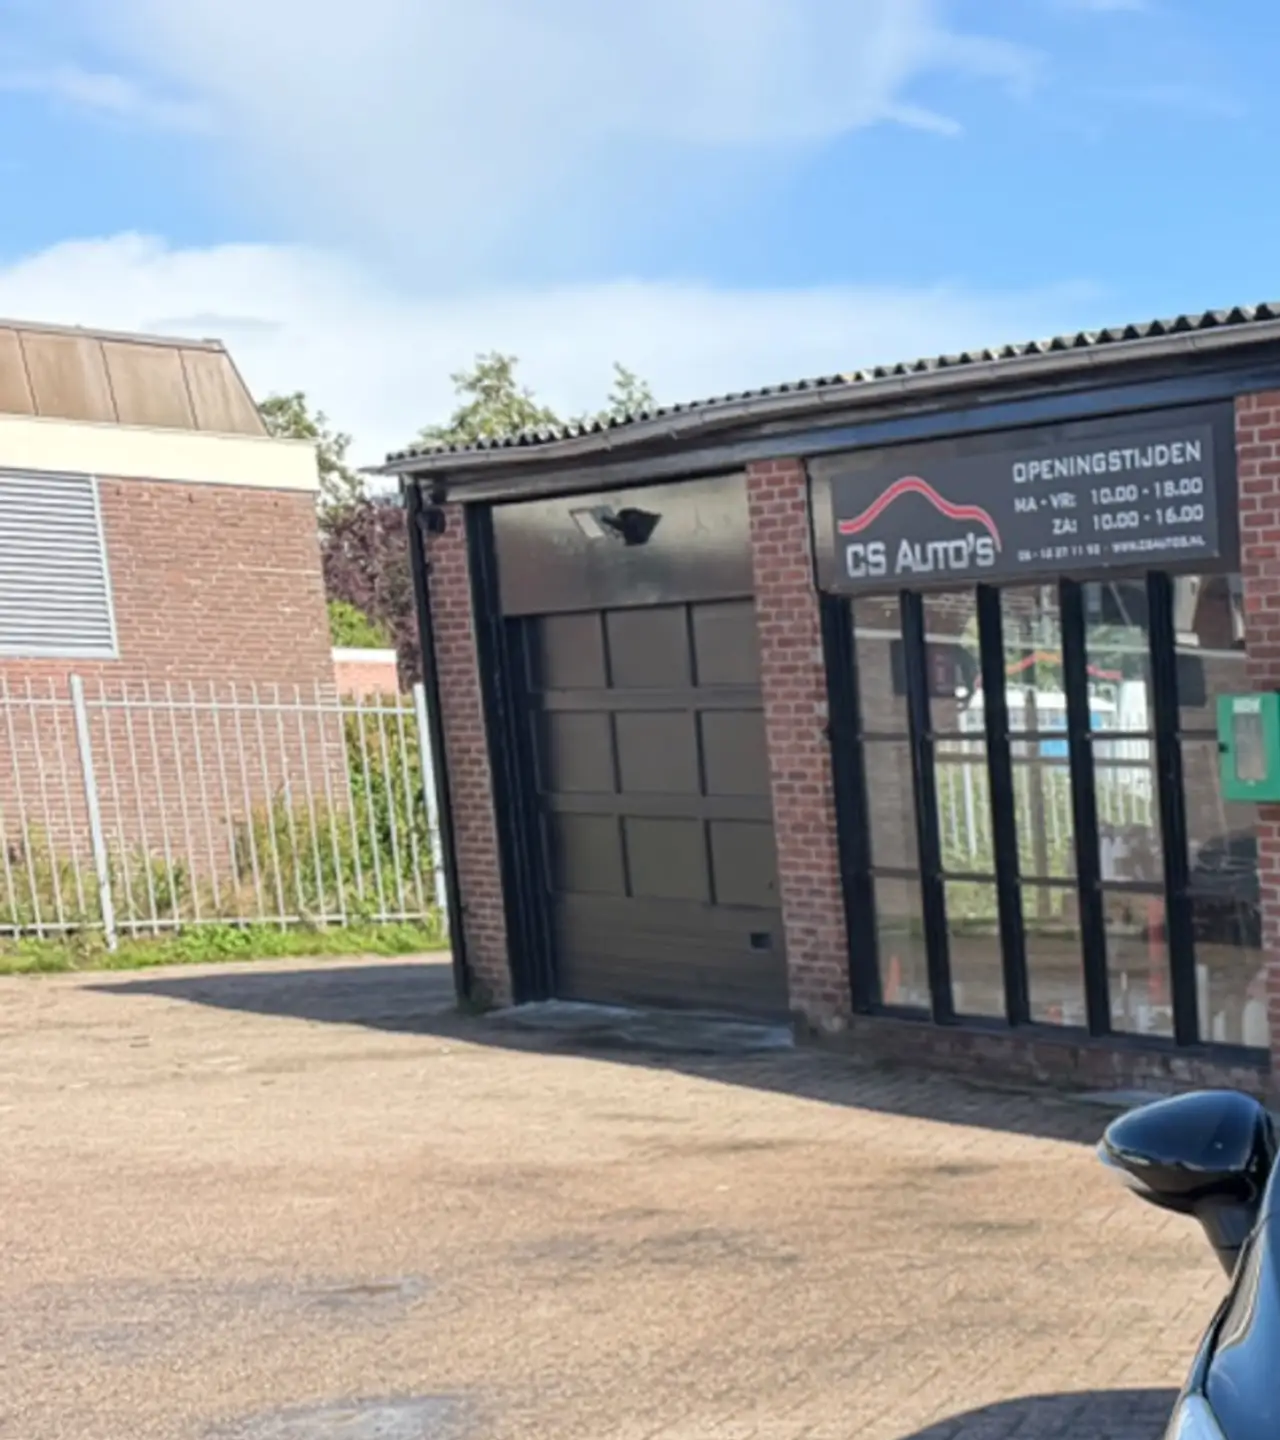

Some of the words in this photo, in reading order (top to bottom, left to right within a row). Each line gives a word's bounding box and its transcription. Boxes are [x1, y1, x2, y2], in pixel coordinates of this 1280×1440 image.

[1013, 440, 1202, 483] OPENINGSTIJDEN
[1014, 496, 1038, 513] MA
[1091, 484, 1139, 505] 10.00
[1052, 517, 1077, 535] ZA:
[1093, 510, 1139, 531] 10.00
[1156, 504, 1204, 525] 16.00
[846, 541, 887, 578] CS
